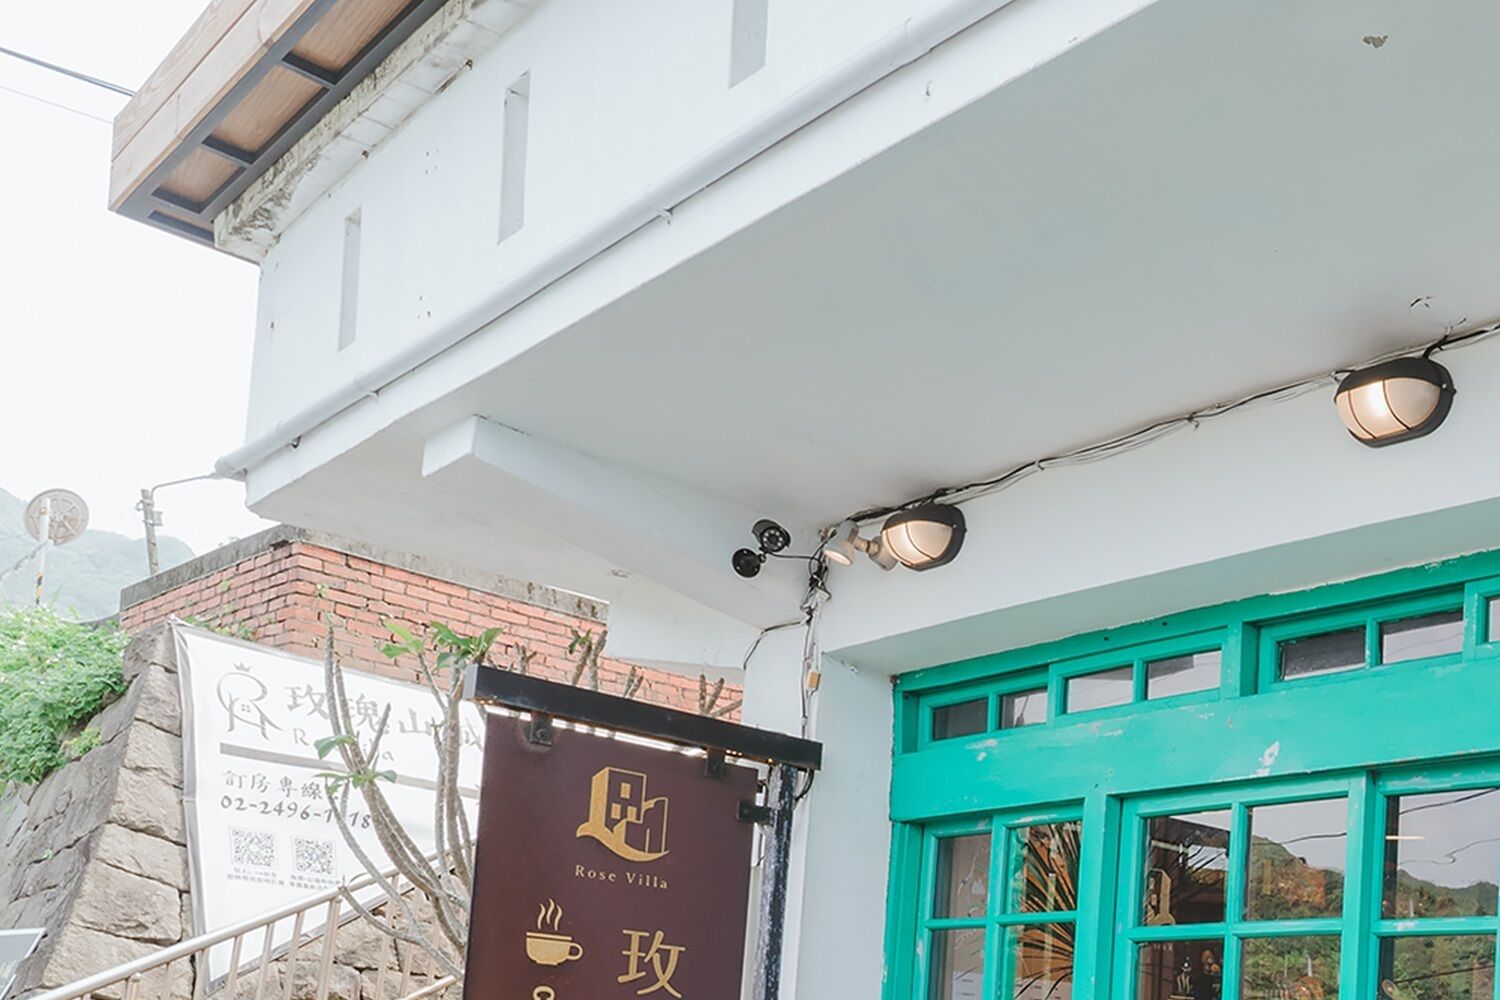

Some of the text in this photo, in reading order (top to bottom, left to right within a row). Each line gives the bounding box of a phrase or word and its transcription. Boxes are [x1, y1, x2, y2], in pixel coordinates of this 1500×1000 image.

[220, 795, 371, 829] 02-2496-118
[574, 864, 668, 889] Rose Villa
